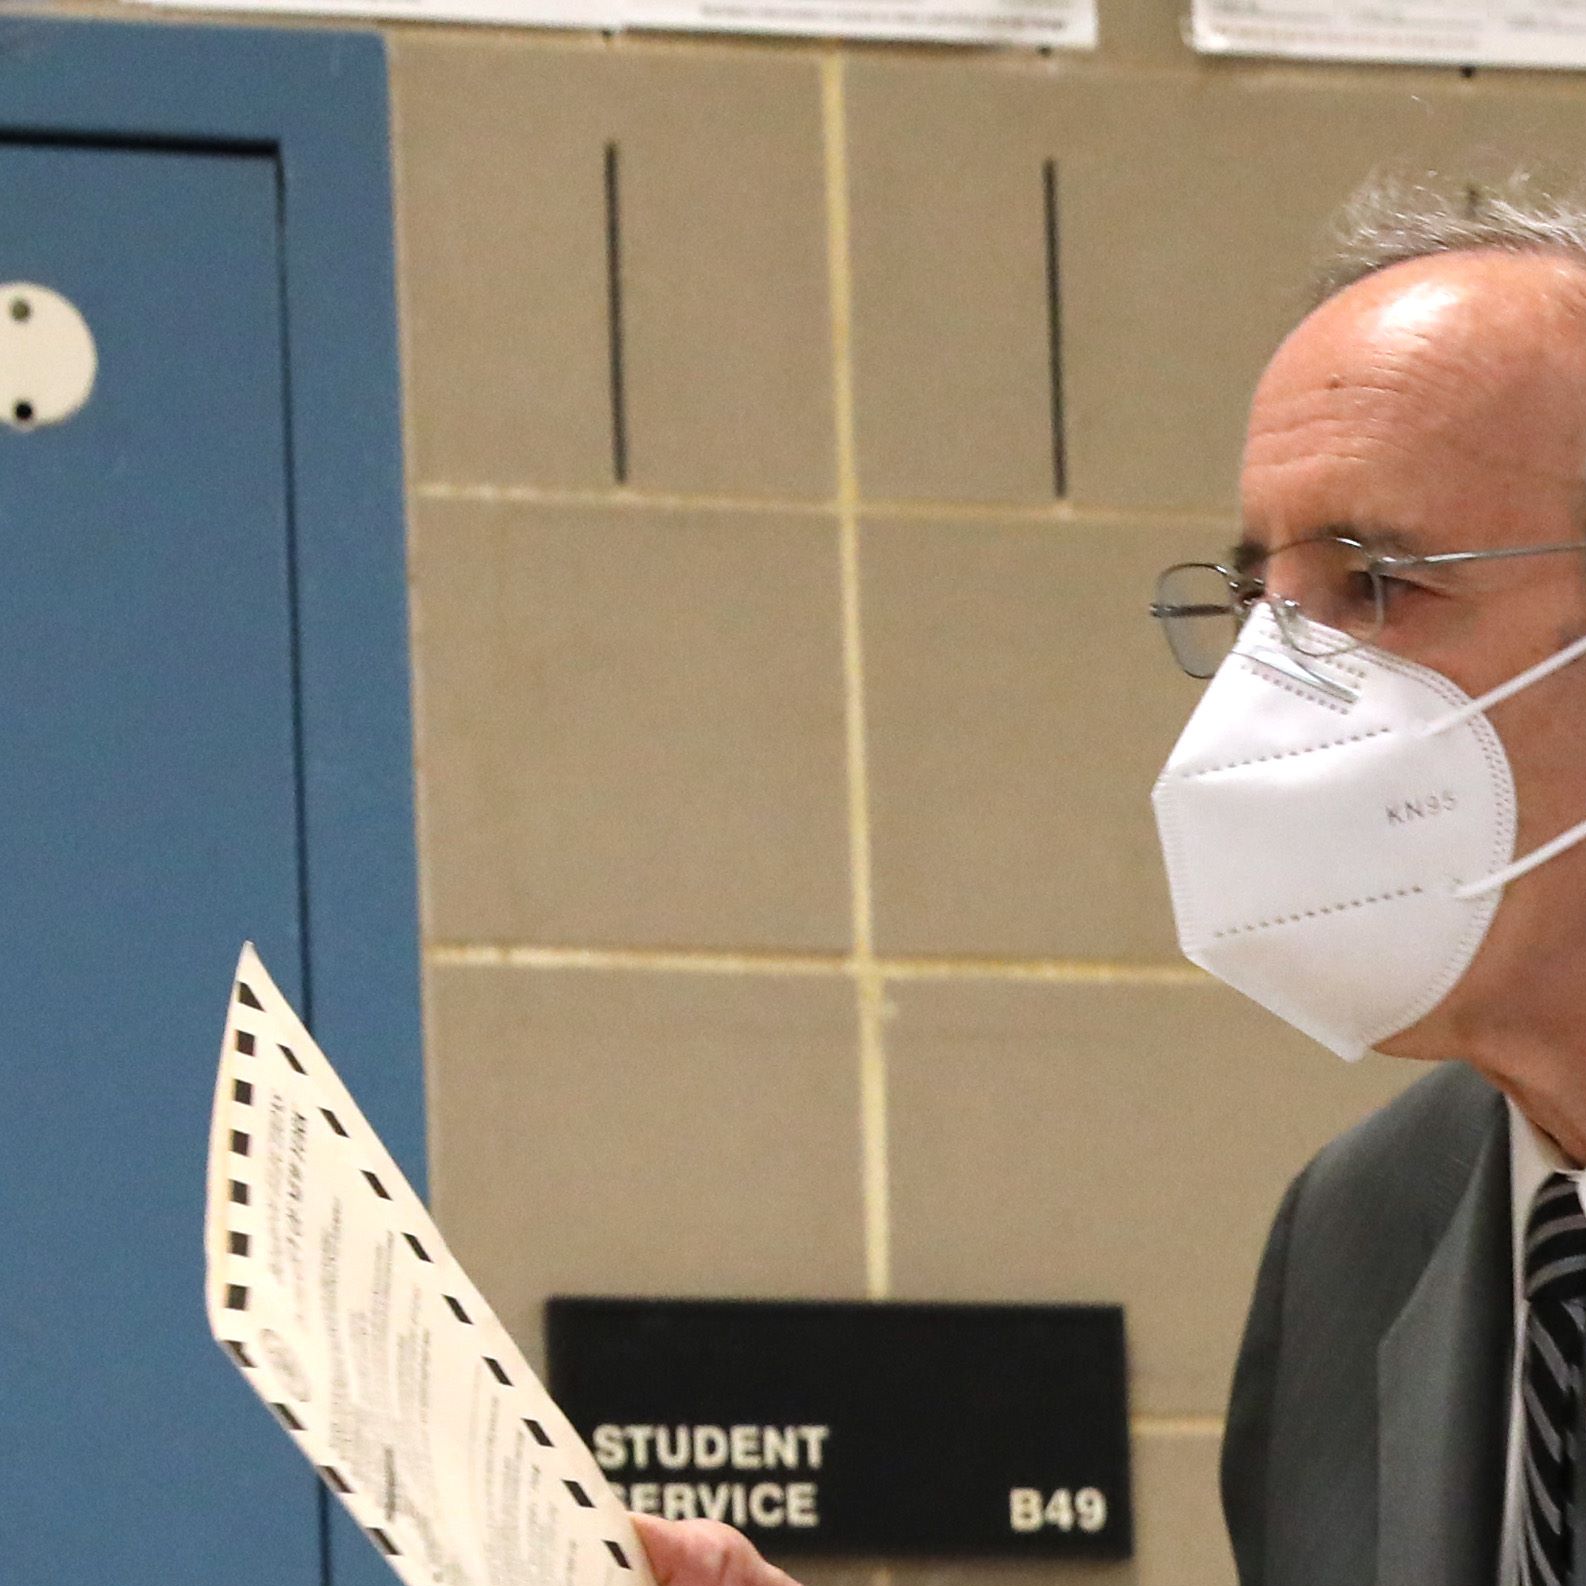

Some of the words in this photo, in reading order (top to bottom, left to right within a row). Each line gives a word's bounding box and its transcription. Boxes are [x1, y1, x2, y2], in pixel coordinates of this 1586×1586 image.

[1384, 789, 1457, 826] KN95
[593, 1423, 829, 1470] STUDENT
[1008, 1488, 1106, 1532] B49
